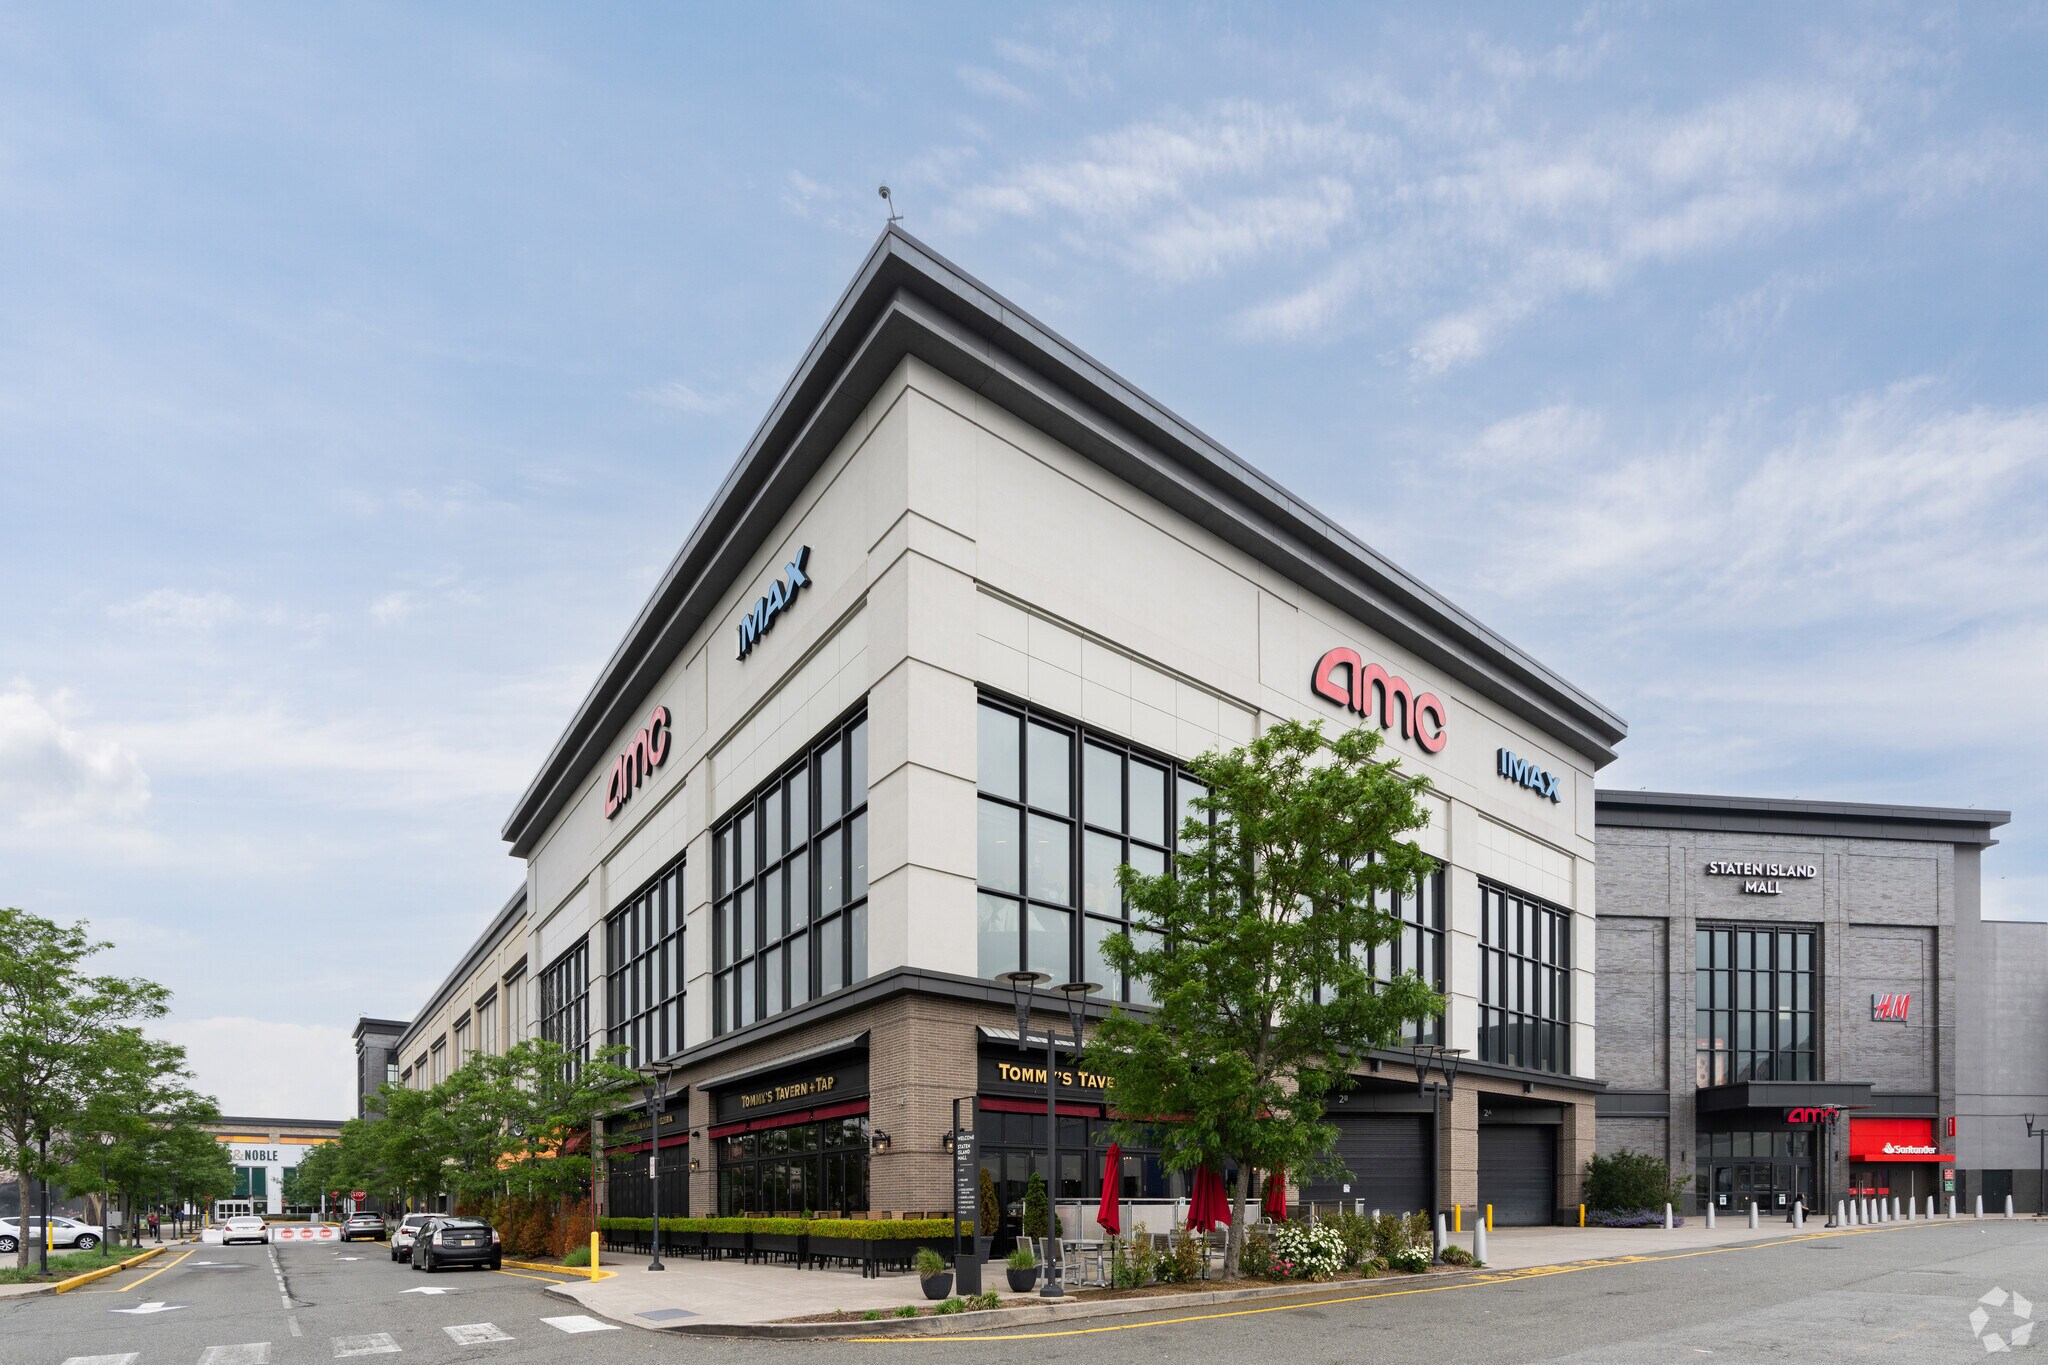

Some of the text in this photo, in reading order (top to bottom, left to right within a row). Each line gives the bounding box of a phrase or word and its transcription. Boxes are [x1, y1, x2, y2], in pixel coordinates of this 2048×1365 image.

[736, 544, 811, 661] IMAX
[1497, 747, 1562, 804] IMAX
[1709, 861, 1817, 878] STATEN ISLAND
[1745, 880, 1783, 894] MALL
[1874, 993, 1911, 1021] H&M
[998, 1062, 1116, 1089] TOMM'S TAVE
[741, 1090, 773, 1109] TOMMY'S
[775, 1082, 808, 1101] TAVERN
[815, 1076, 834, 1092] TAP
[244, 1149, 278, 1161] NOBLE
[1894, 1145, 1937, 1154] Santander
